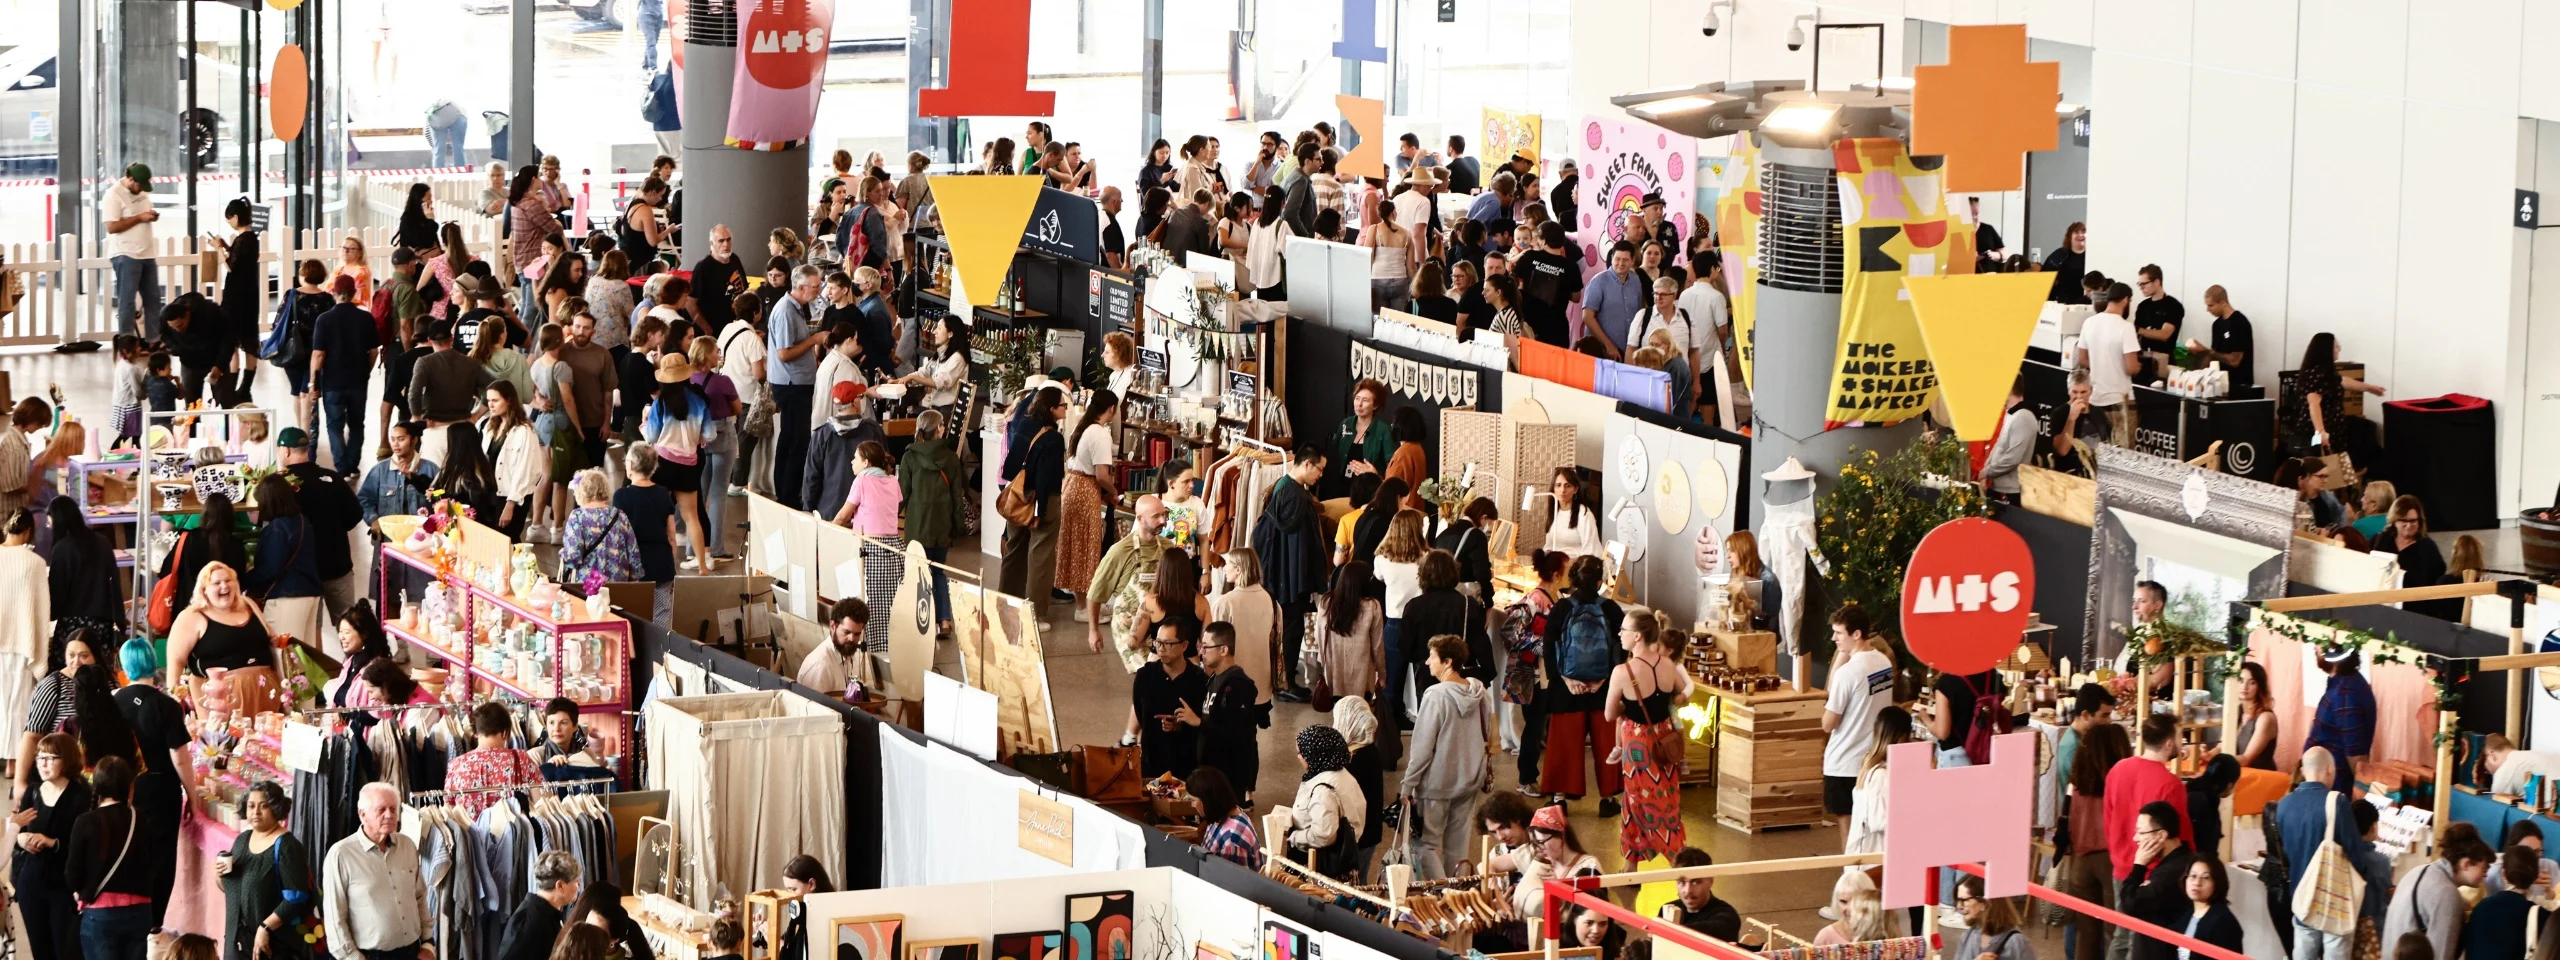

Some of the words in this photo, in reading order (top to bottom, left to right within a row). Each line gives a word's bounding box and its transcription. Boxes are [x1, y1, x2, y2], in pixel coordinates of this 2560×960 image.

[751, 27, 824, 54] M+S
[1597, 152, 1626, 210] SWEET
[1535, 265, 1560, 276] ROMANCE
[1540, 262, 1565, 274] CHEMICAL
[1109, 295, 1129, 308] LIMITED
[1109, 304, 1128, 317] RELEASE
[1353, 348, 1475, 399] POOLHOUSE
[2134, 426, 2177, 451] COFFEE
[1911, 570, 2021, 614] M+S
